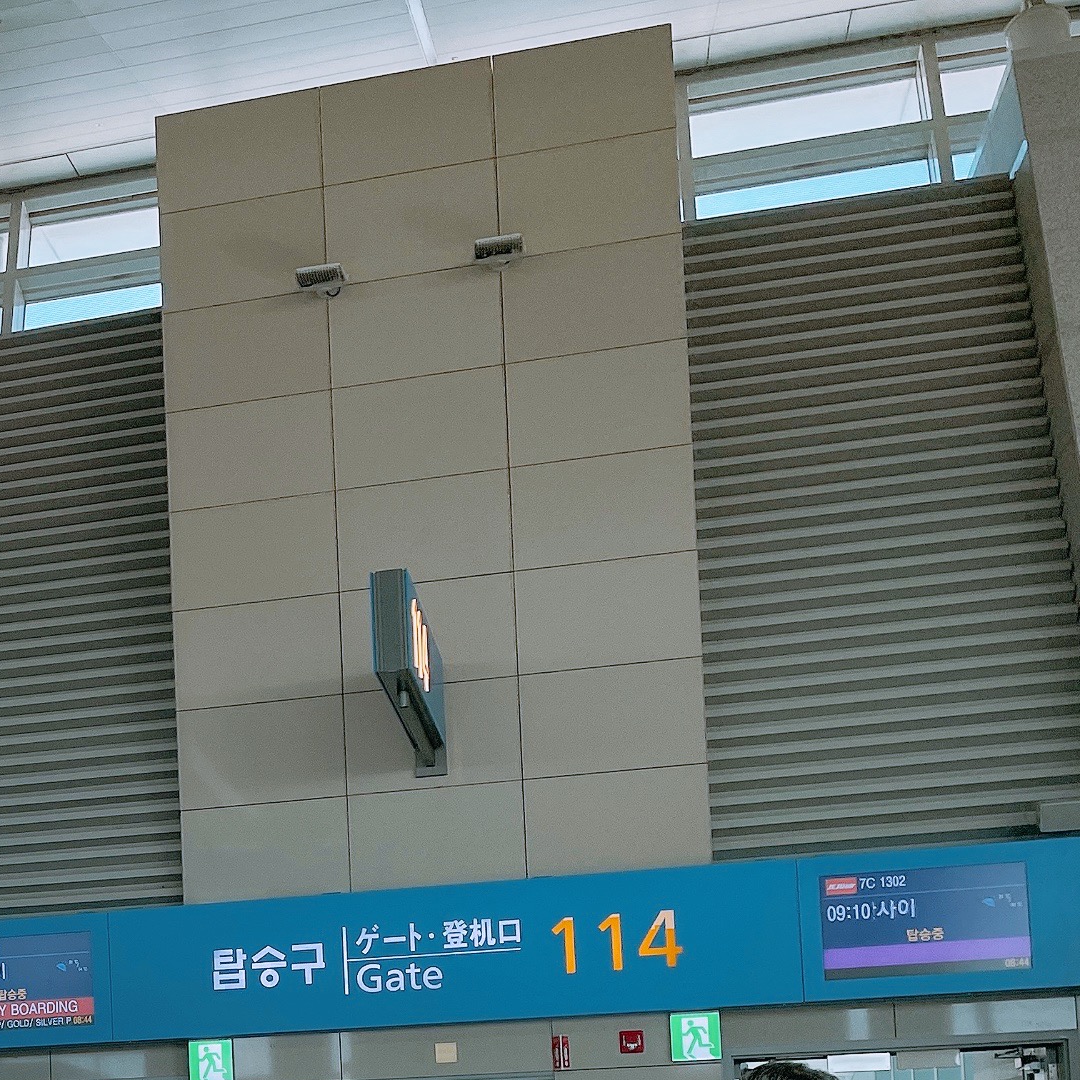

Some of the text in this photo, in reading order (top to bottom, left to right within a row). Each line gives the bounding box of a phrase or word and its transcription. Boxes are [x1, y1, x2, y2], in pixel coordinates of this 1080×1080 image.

[859, 877, 875, 889] 7C
[880, 875, 906, 888] 1302
[551, 909, 684, 974] 114
[212, 942, 326, 990] 탑승구
[355, 962, 444, 993] Gate
[10, 1000, 79, 1016] BOARDING
[6, 1018, 32, 1029] GOLD/
[35, 1016, 64, 1027] SILVER
